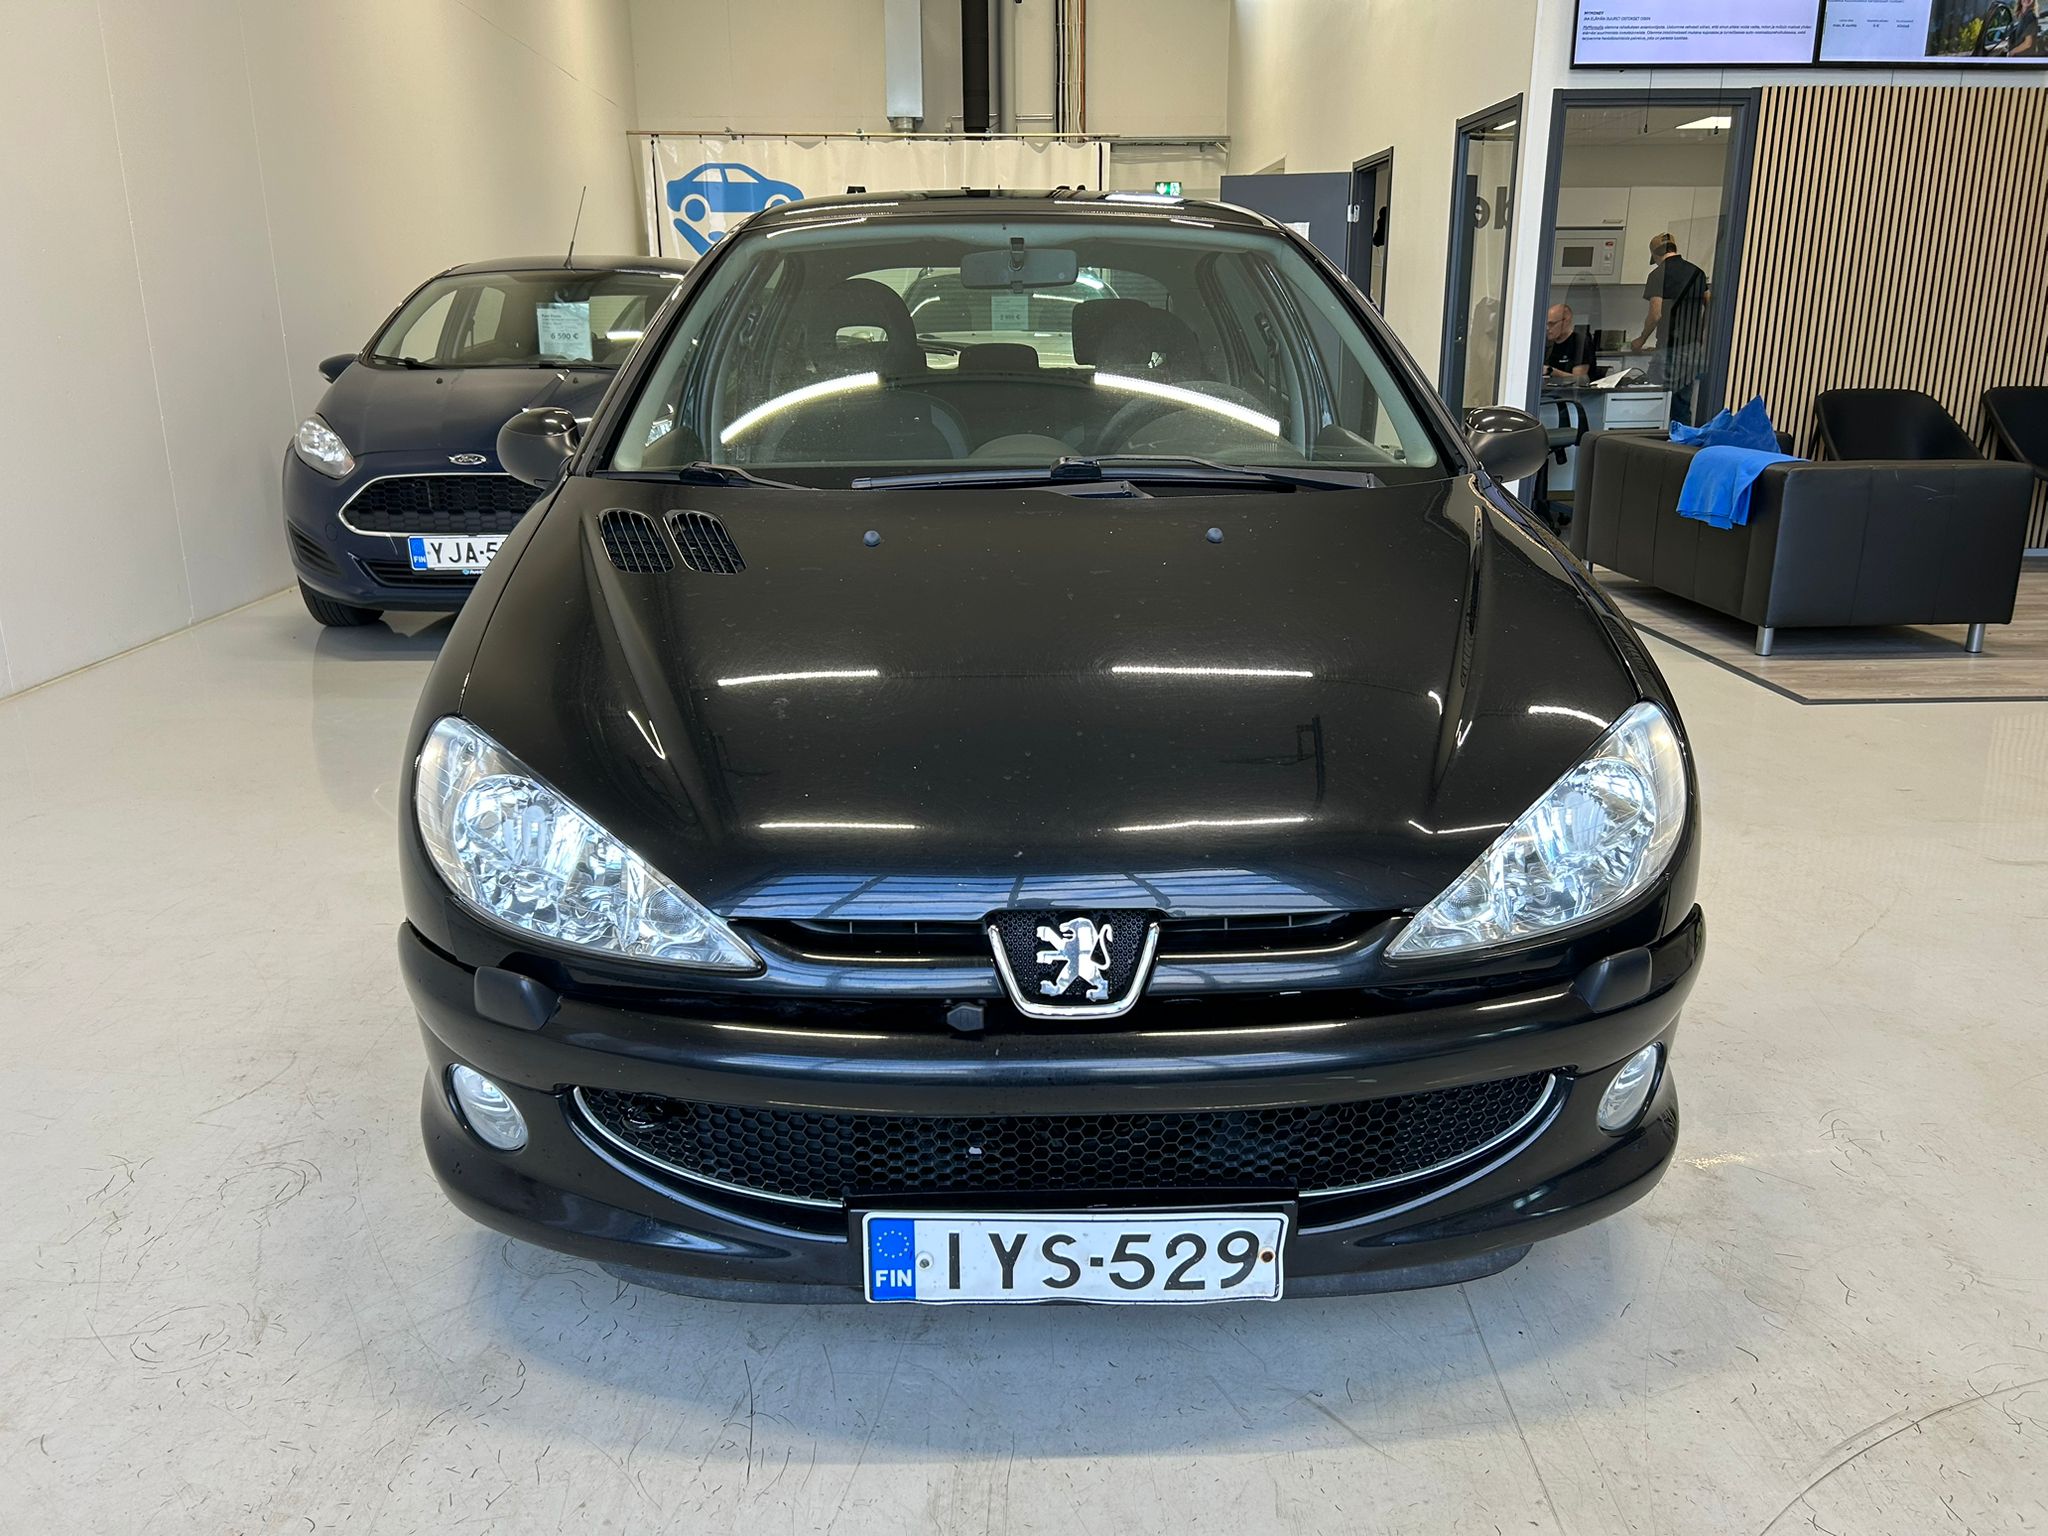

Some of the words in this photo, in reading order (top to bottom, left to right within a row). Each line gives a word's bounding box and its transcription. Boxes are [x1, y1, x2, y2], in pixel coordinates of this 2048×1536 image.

[550, 332, 556, 340] 6
[430, 542, 505, 564] YJA-5
[875, 1269, 912, 1287] FIN
[948, 1230, 1260, 1291] IYS-529
